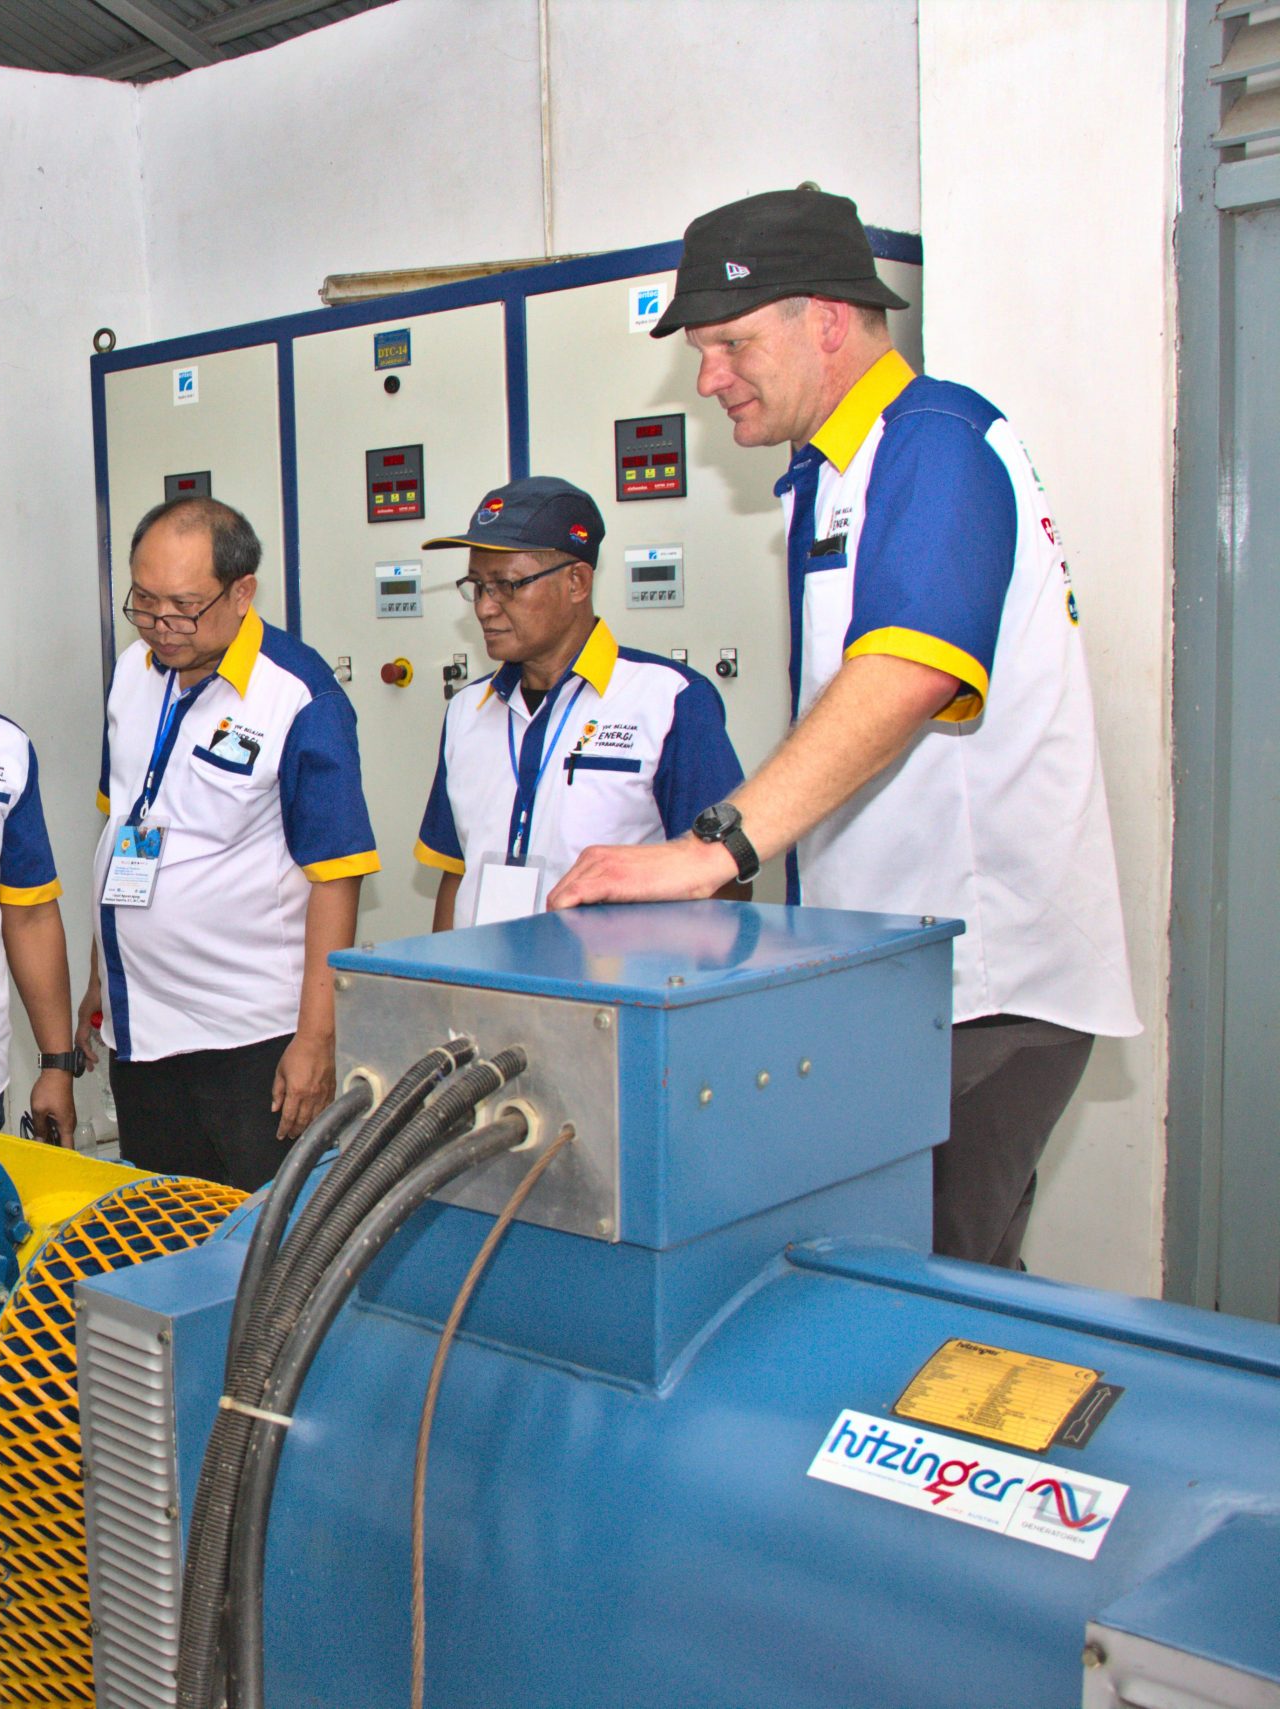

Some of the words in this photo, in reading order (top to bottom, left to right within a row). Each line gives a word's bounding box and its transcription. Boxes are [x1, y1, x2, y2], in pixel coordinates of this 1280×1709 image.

[599, 732, 633, 741] ENERGI
[956, 1341, 1001, 1356] hitzinger
[828, 1418, 1024, 1506] hitzinger
[1020, 1520, 1086, 1545] GENERATOREN
